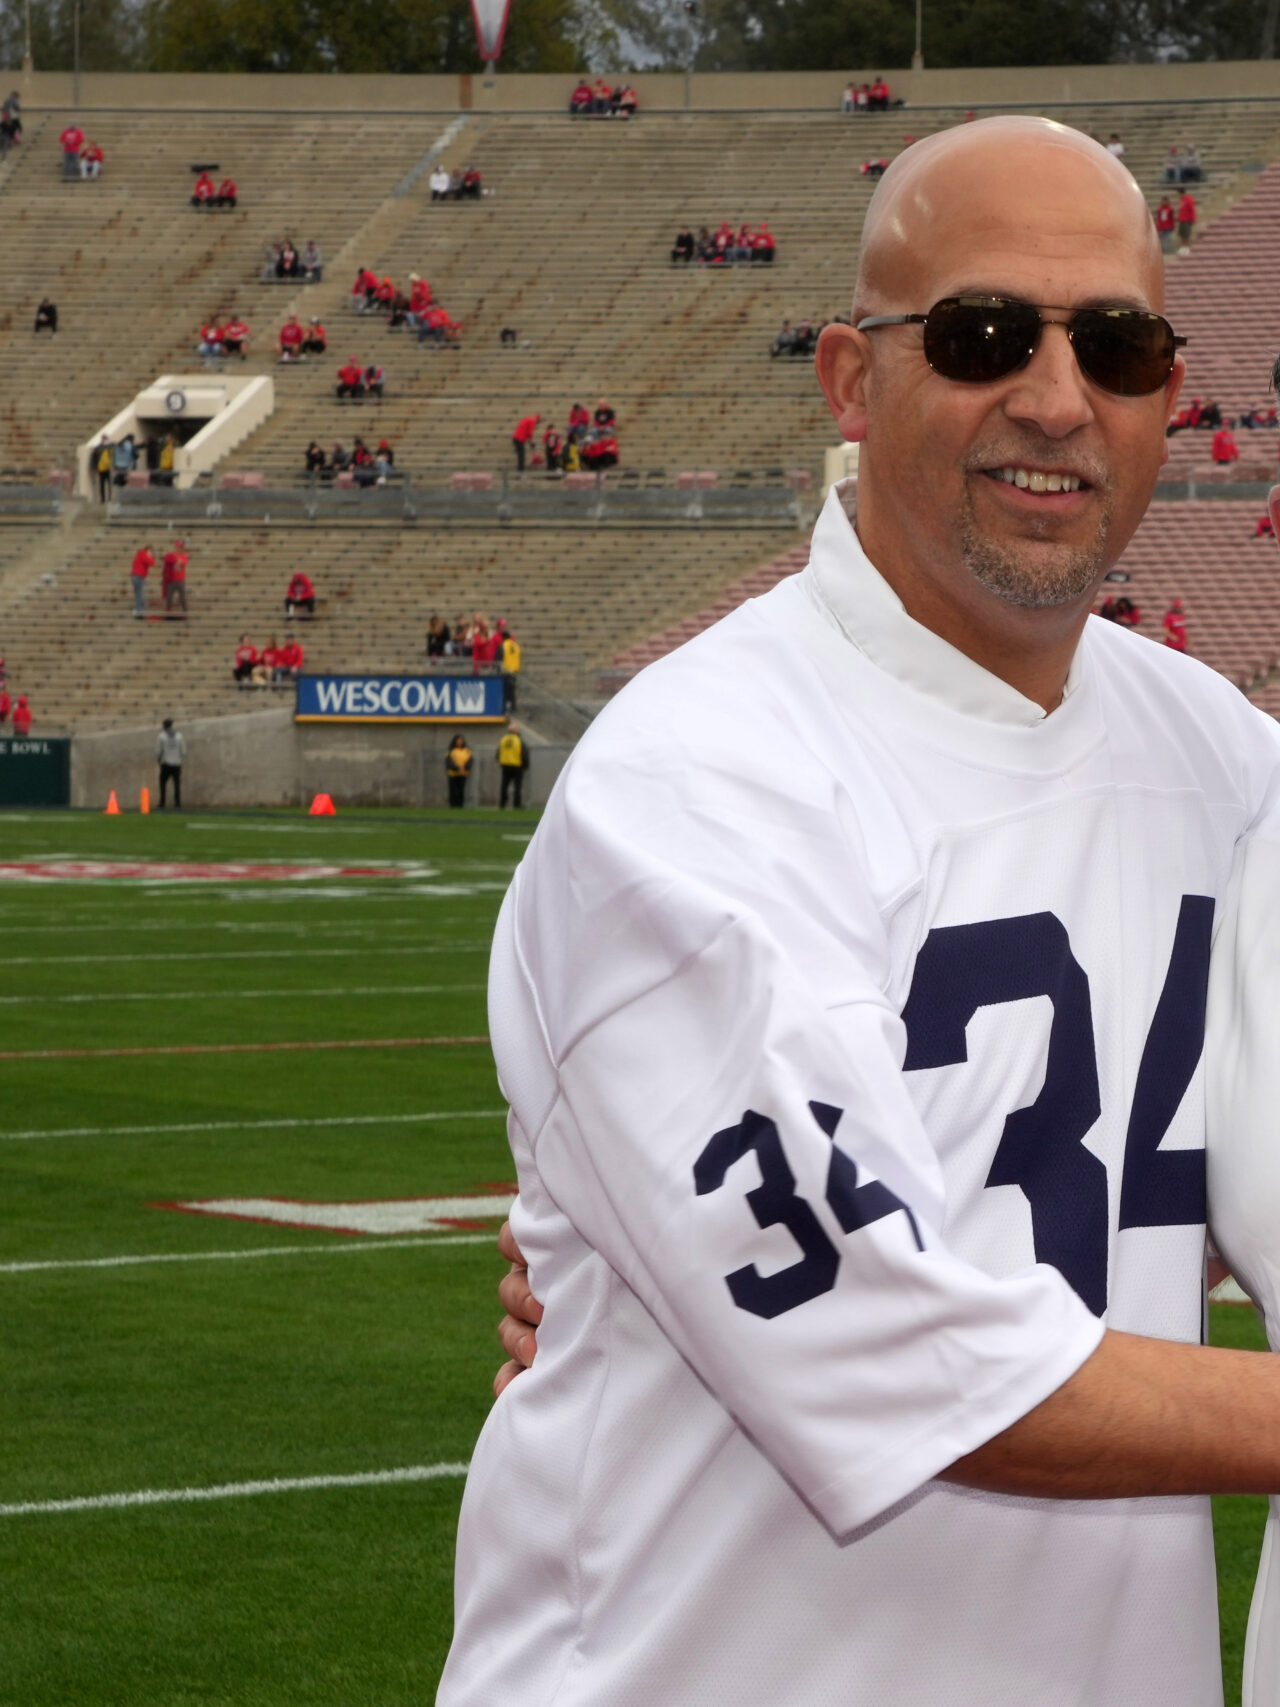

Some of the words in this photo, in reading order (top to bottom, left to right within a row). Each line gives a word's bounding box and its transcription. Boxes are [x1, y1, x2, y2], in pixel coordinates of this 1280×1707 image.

[11, 742, 51, 755] BOWL
[316, 681, 451, 713] WESCOM
[900, 894, 1216, 1319] 34
[692, 1099, 926, 1320] 34
